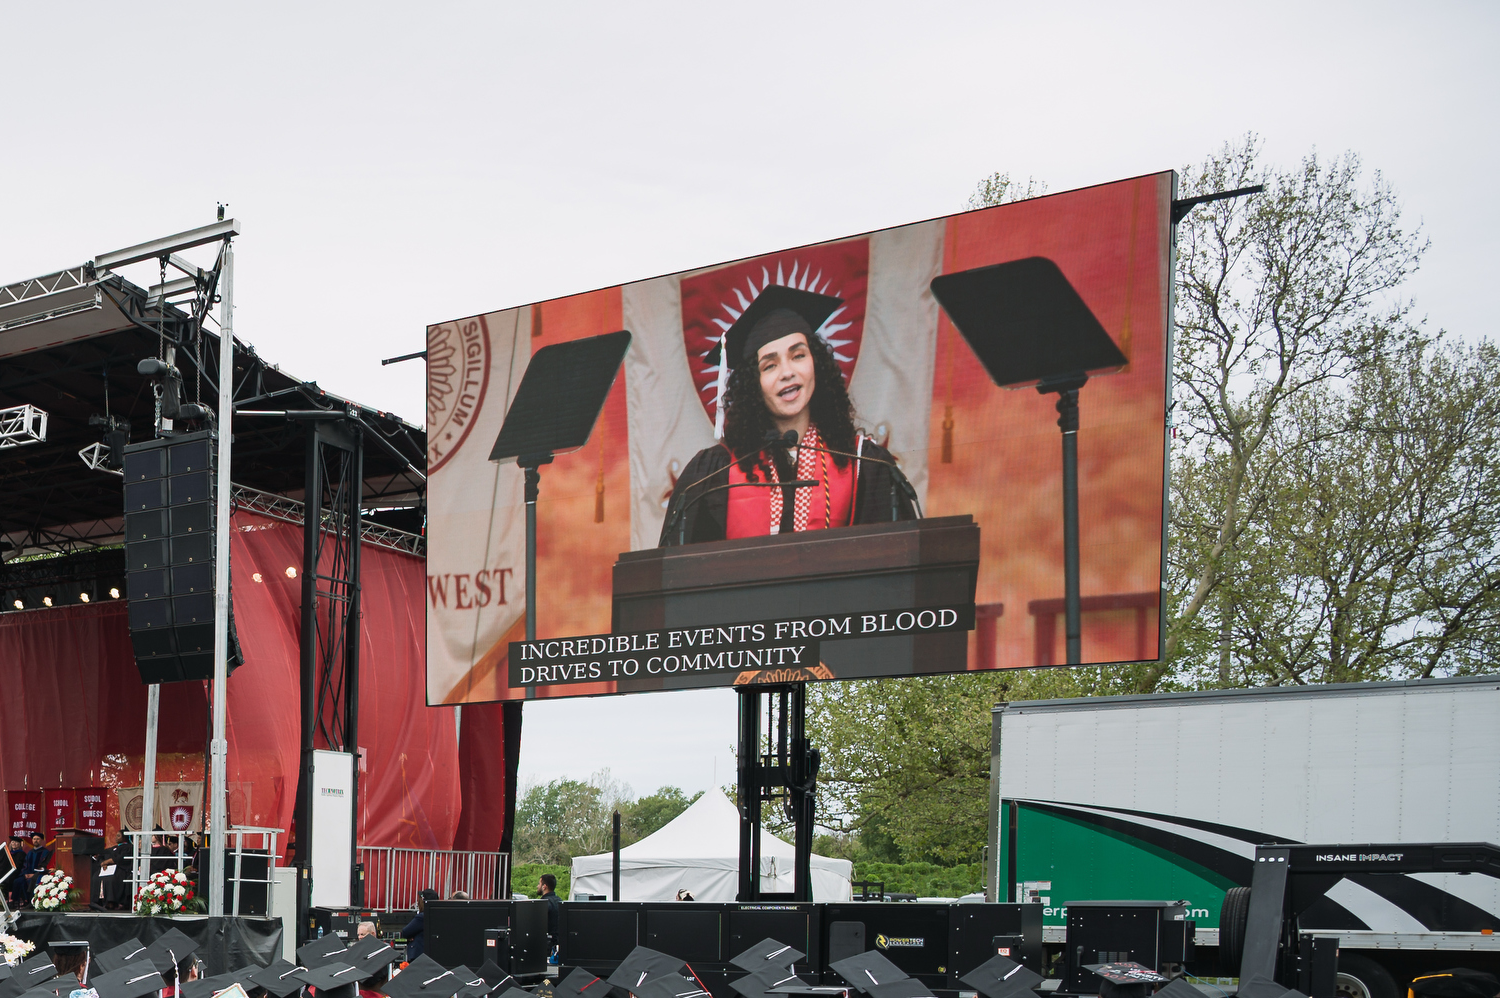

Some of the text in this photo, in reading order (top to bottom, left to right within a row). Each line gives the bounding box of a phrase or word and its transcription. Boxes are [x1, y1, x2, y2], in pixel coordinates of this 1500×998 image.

[452, 321, 481, 427] SIGILLUM
[427, 568, 513, 611] WEST
[520, 608, 958, 660] INCREDIBLE EVENTS FROM BLOOD
[520, 661, 601, 683] DRIVES
[608, 658, 639, 677] TO
[646, 645, 806, 674] COMMUNITY
[14, 803, 36, 811] COLLEGE
[22, 811, 28, 819] OF
[26, 821, 37, 829] AND
[1359, 853, 1404, 861] IMPACT
